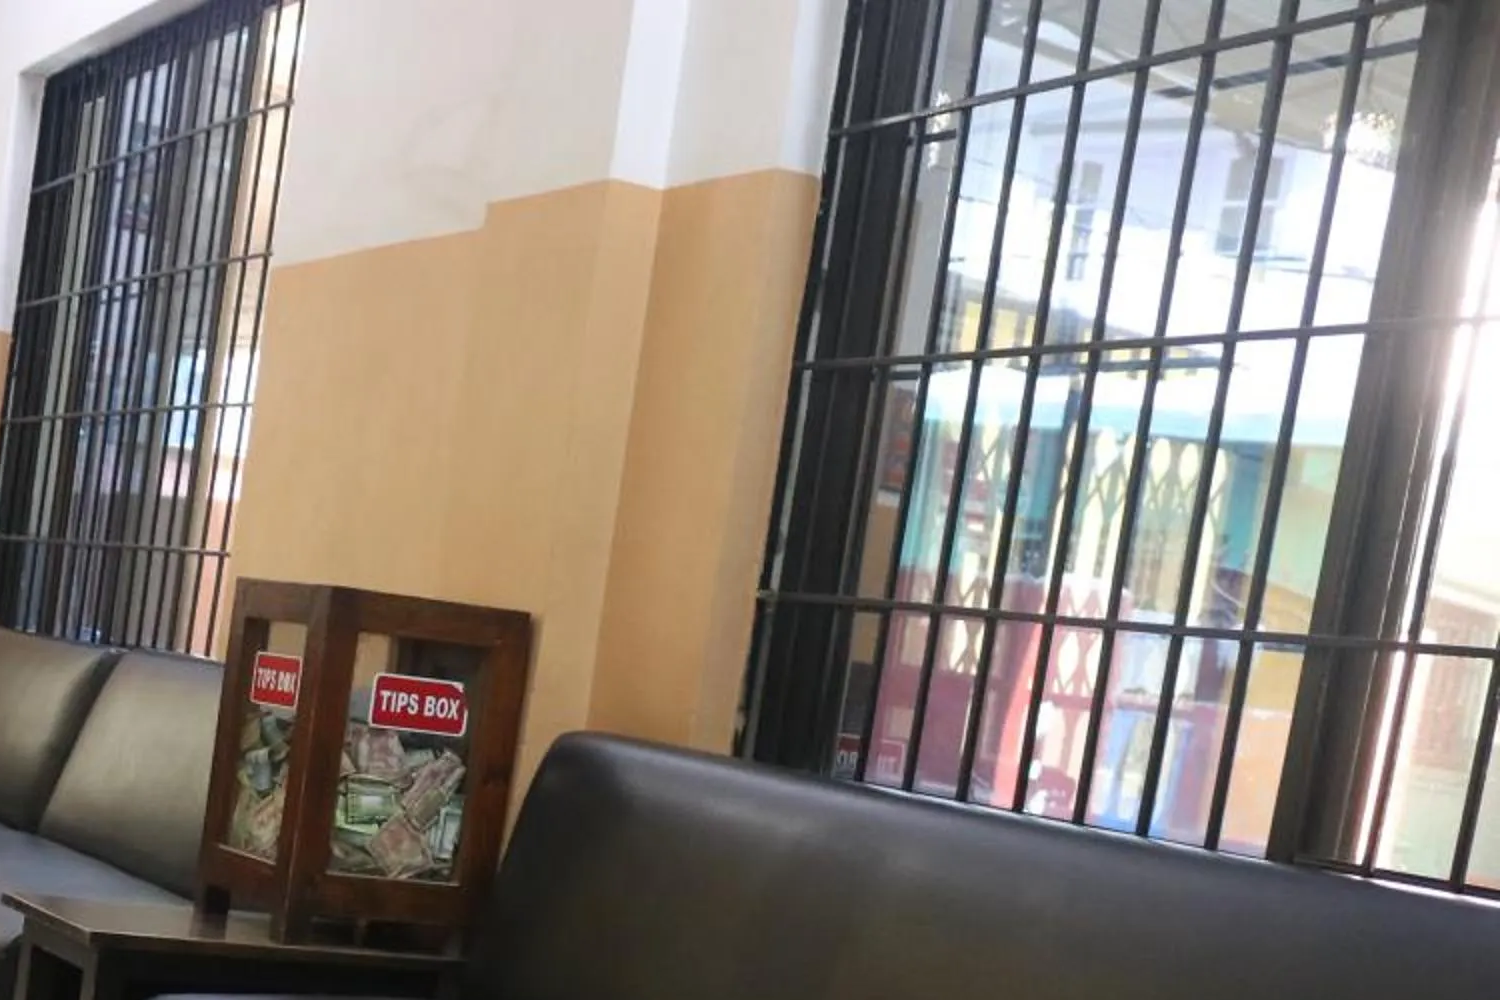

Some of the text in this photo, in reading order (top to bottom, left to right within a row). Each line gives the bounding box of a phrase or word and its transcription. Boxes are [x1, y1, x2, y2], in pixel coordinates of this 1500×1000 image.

[257, 668, 277, 691] TIPS
[380, 689, 461, 720] TIPS BOX
